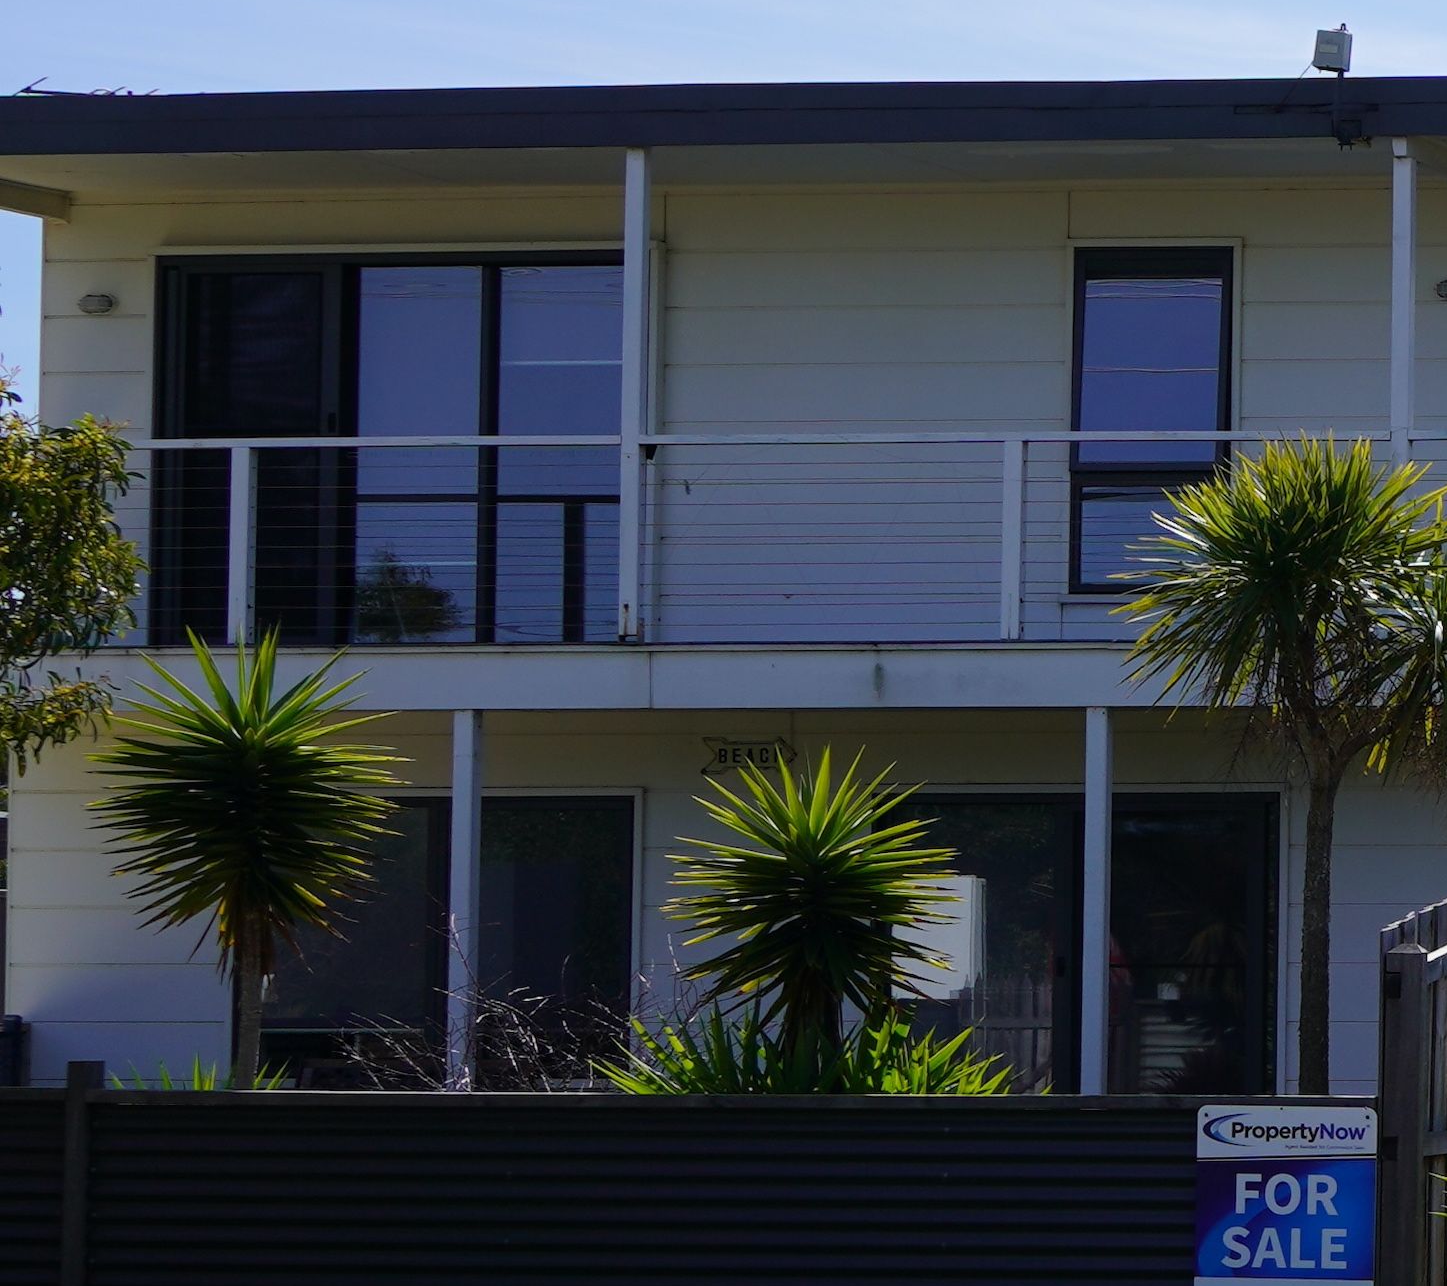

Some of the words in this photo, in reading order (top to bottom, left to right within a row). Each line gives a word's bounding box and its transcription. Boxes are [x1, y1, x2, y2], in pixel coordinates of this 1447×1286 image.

[1231, 1121, 1366, 1143] PropertyNow
[1235, 1173, 1339, 1216] FOR
[1220, 1226, 1348, 1270] SALE
